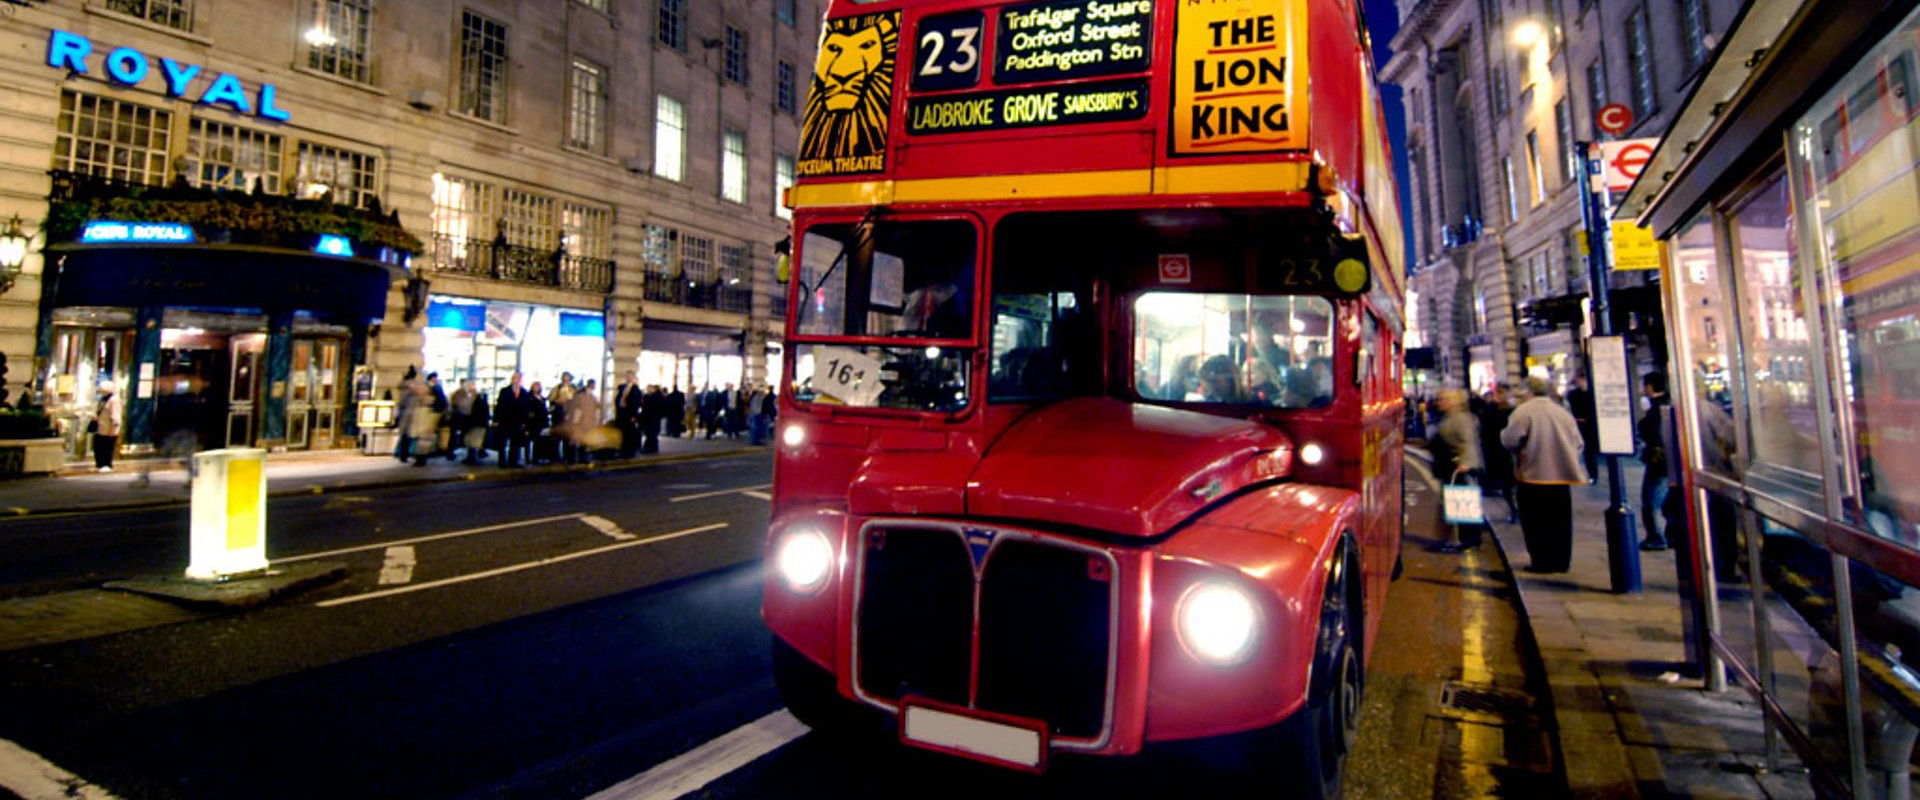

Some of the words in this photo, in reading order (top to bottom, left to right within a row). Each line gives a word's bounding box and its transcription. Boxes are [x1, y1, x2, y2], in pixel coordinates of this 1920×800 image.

[1005, 7, 1080, 30] Trafalgar
[1086, 0, 1151, 23] Square
[1208, 15, 1275, 47] THE
[919, 26, 980, 77] 23
[1012, 25, 1076, 51] Oxford
[1080, 21, 1141, 42] Street
[1005, 48, 1104, 71] Paddington
[1110, 41, 1143, 61] Stn
[48, 29, 291, 122] ROYAL
[1194, 57, 1286, 93] LION
[913, 98, 994, 130] LADBROKE
[1003, 92, 1059, 123] GROVE
[1063, 90, 1138, 115] SAINSBURY'S
[1191, 103, 1289, 140] KING
[1602, 106, 1623, 128] C
[796, 159, 834, 175] YCEUM
[835, 154, 884, 173] THEATRE
